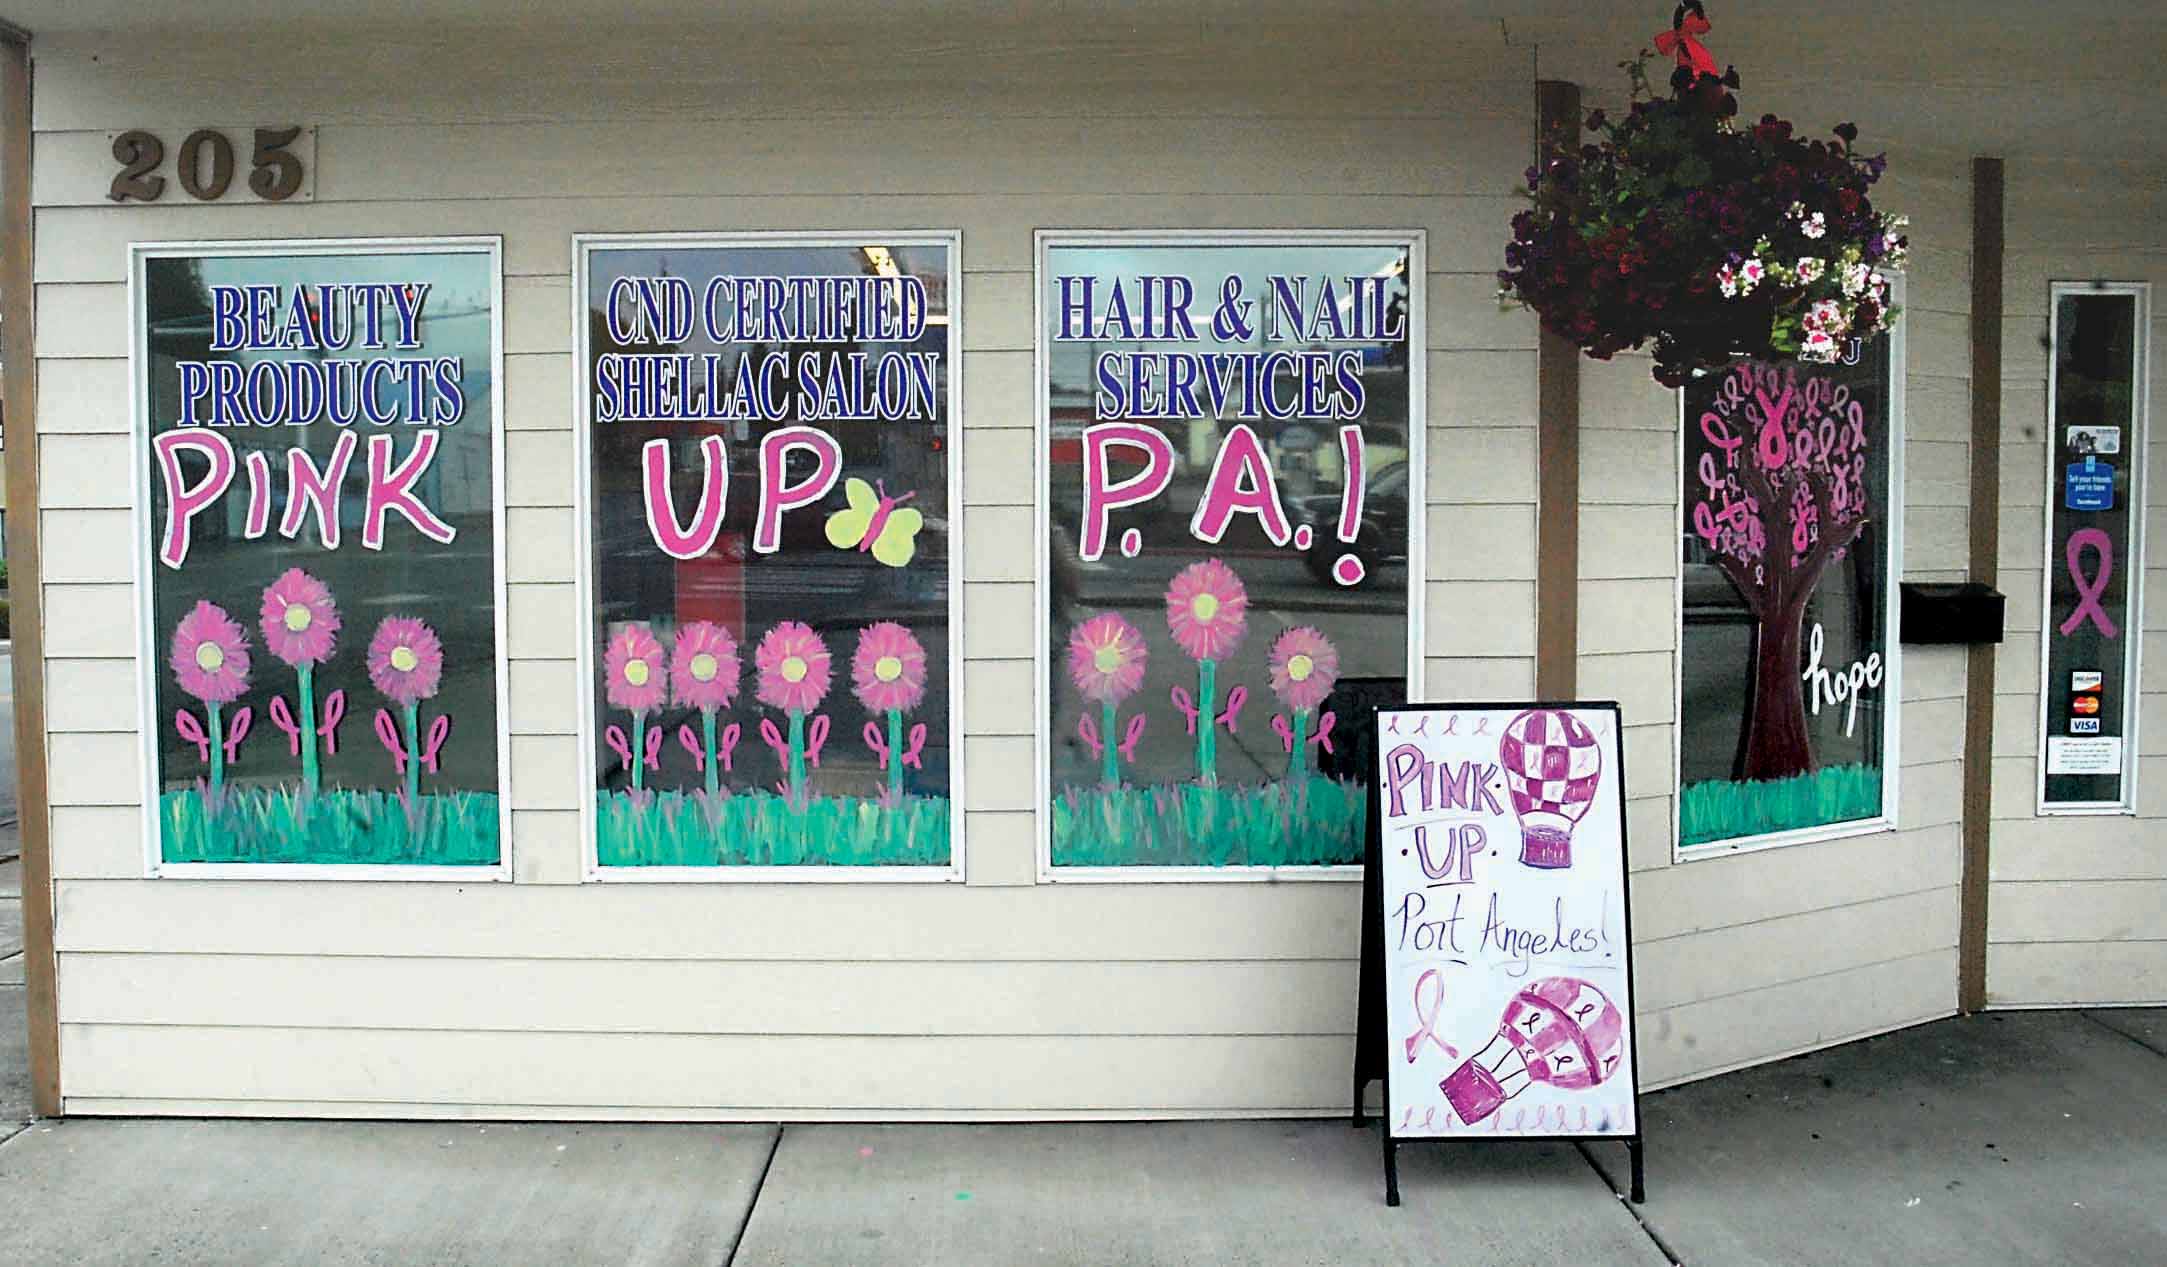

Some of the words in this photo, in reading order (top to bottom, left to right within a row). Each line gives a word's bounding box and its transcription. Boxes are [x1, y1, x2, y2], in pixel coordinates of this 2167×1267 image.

[106, 127, 303, 201] 205
[210, 283, 432, 352] BEAUTY
[606, 276, 695, 345] CND
[704, 275, 927, 343] CERTIFIED
[1055, 275, 1199, 342] HAIR
[1210, 273, 1255, 342] &
[1267, 275, 1405, 342] NAIL
[177, 357, 464, 427] PRODUCTS
[596, 352, 789, 422] SHELLAC
[798, 352, 939, 420] SALON
[1096, 350, 1365, 420] SERVICES
[153, 428, 457, 569] PINK
[642, 426, 842, 560] UP
[1803, 623, 1883, 737] hope
[2074, 721, 2098, 731] VISA
[1392, 892, 1465, 953] Port
